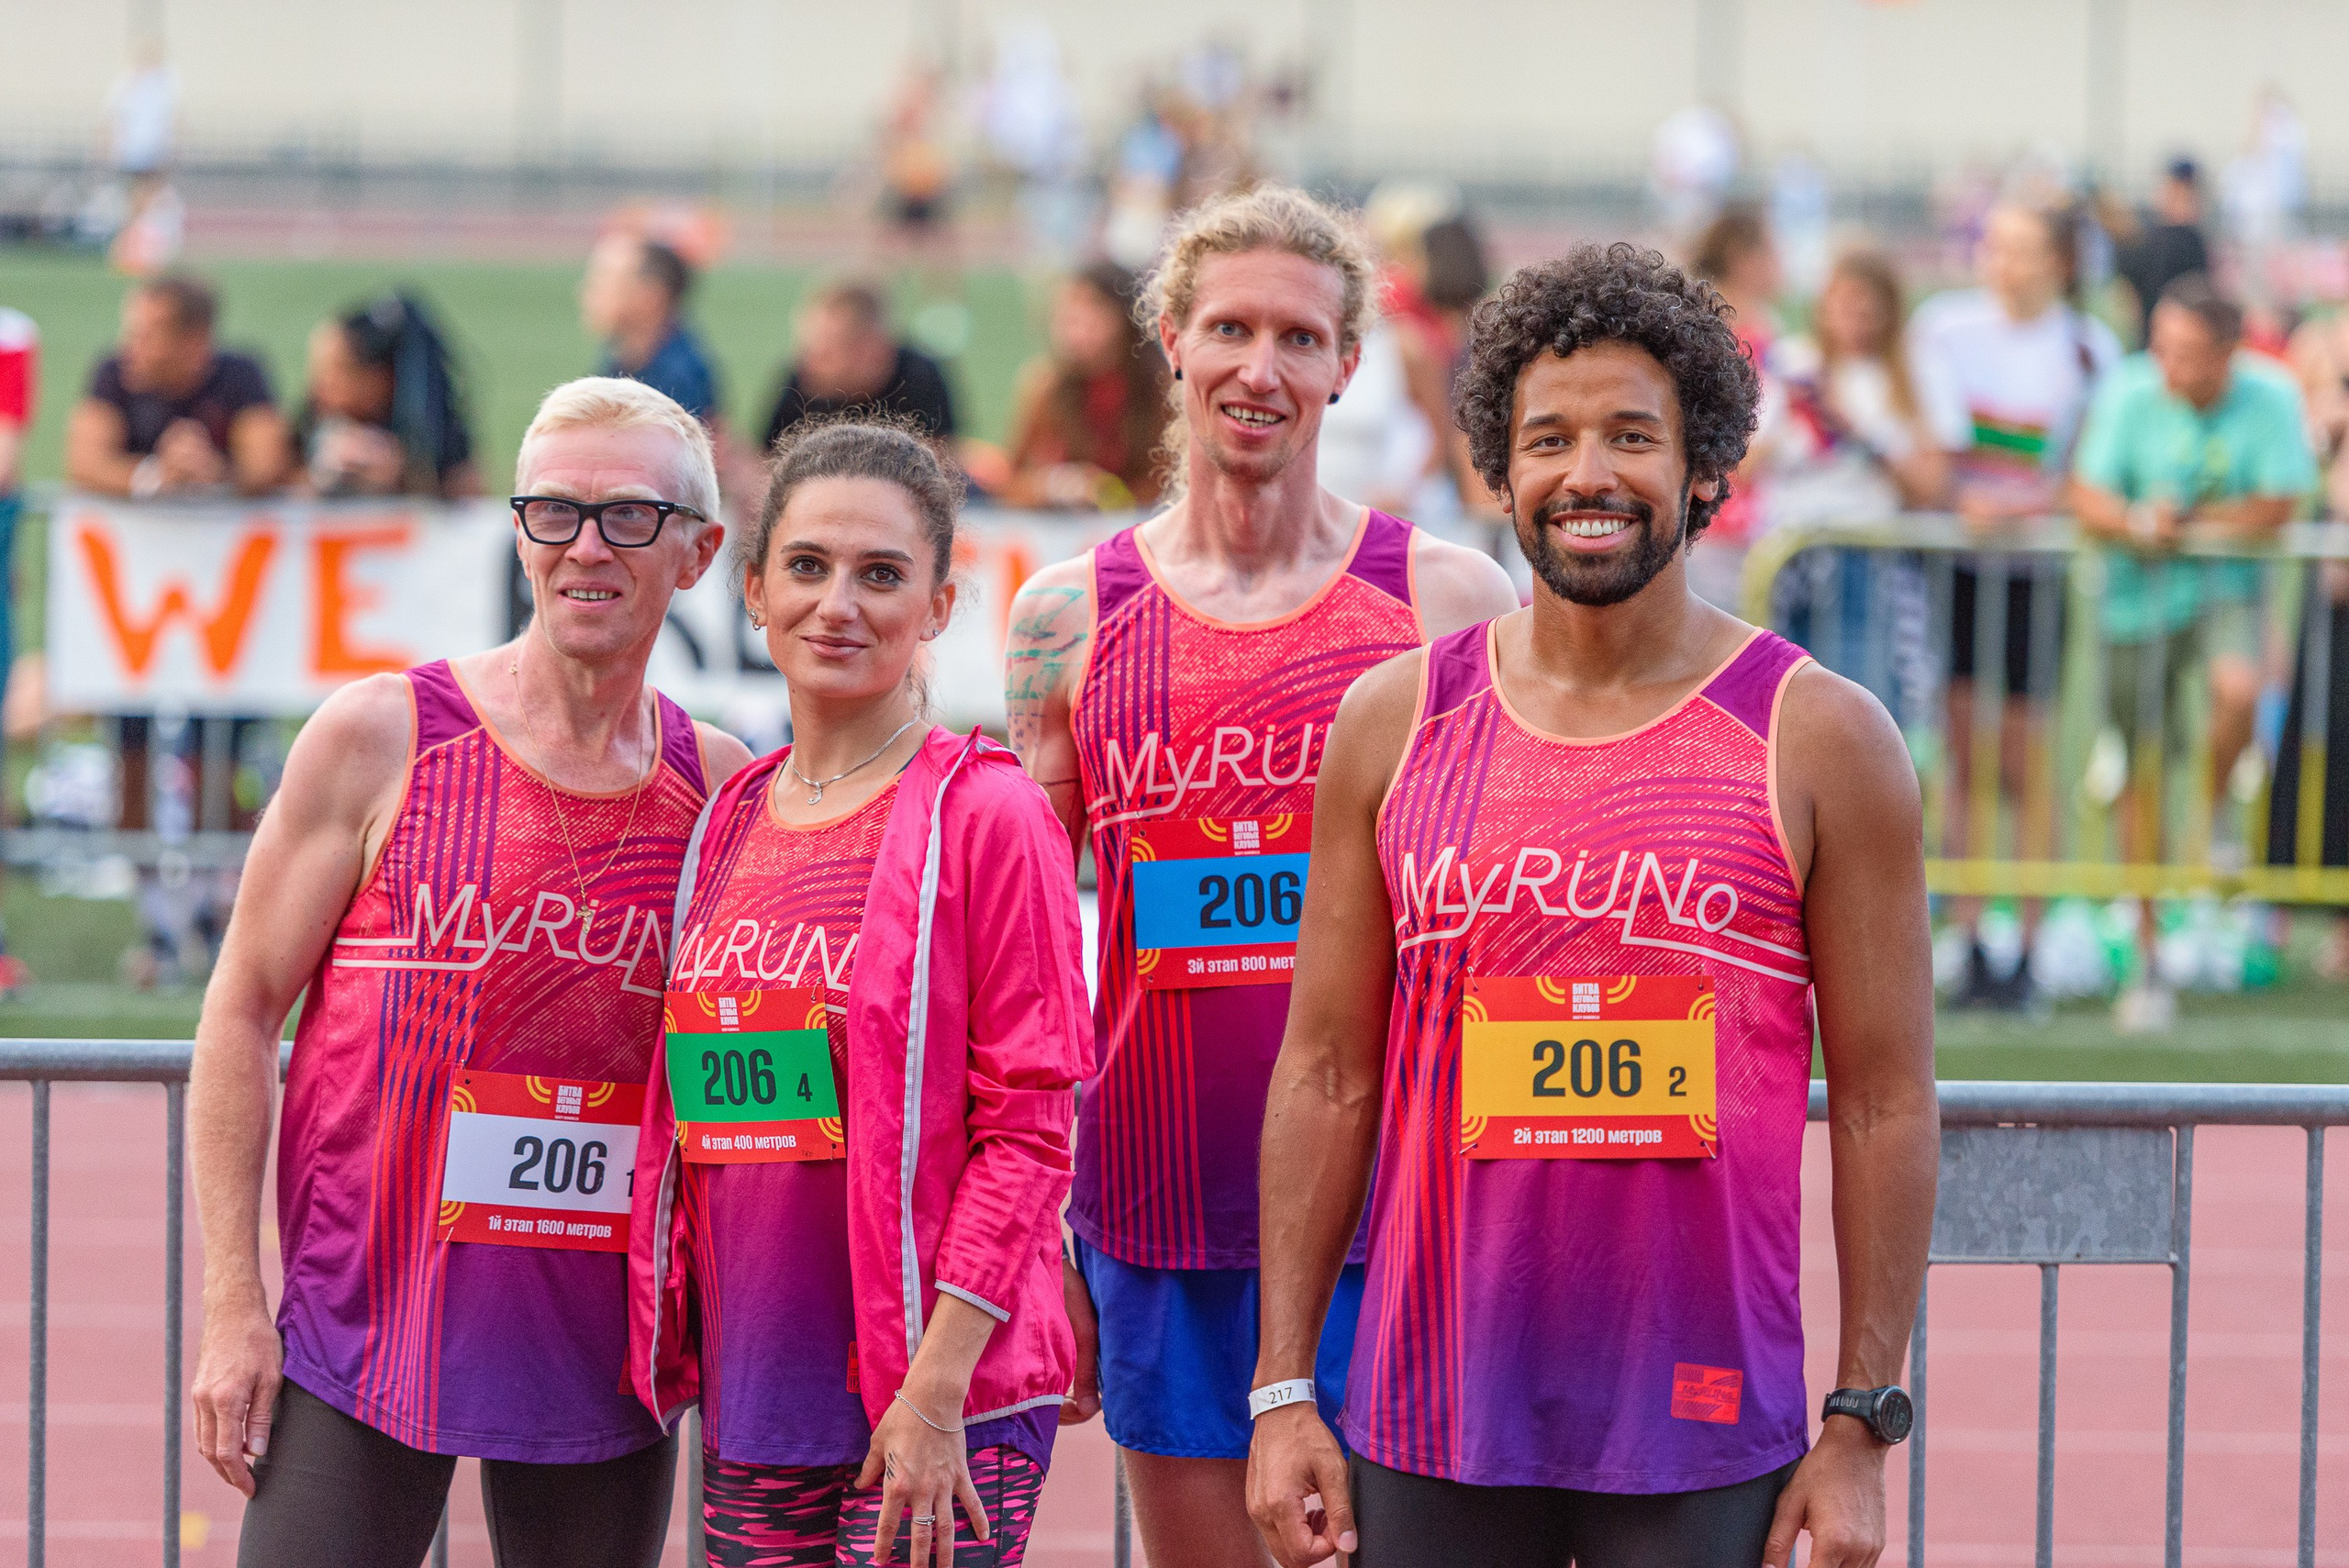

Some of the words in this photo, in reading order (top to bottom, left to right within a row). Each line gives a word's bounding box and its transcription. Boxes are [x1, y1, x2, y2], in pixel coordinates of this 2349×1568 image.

[75, 519, 416, 681] WE
[1199, 872, 1302, 929] 206
[1187, 957, 1204, 973] 3й
[1208, 959, 1238, 973] этап
[1241, 956, 1266, 971] 800
[1573, 983, 1599, 995] БИТВА
[1573, 1003, 1600, 1013] КЛУБОВ
[702, 1049, 776, 1106] 206
[797, 1073, 813, 1102] 4
[1532, 1040, 1642, 1098] 206
[1669, 1066, 1687, 1096] 2
[702, 1134, 711, 1150] 4й
[712, 1137, 732, 1151] этап
[734, 1135, 752, 1150] 400
[754, 1135, 796, 1151] метров
[1514, 1128, 1531, 1144] 2й
[1535, 1129, 1568, 1144] этап
[1571, 1128, 1605, 1144] 1200
[1608, 1129, 1662, 1146] метров
[508, 1136, 607, 1195] 206
[627, 1169, 635, 1197] 1
[488, 1215, 502, 1230] 1й
[504, 1218, 534, 1233] этап
[537, 1218, 565, 1235] 1600
[566, 1223, 612, 1240] метров
[1269, 1386, 1292, 1404] 217
